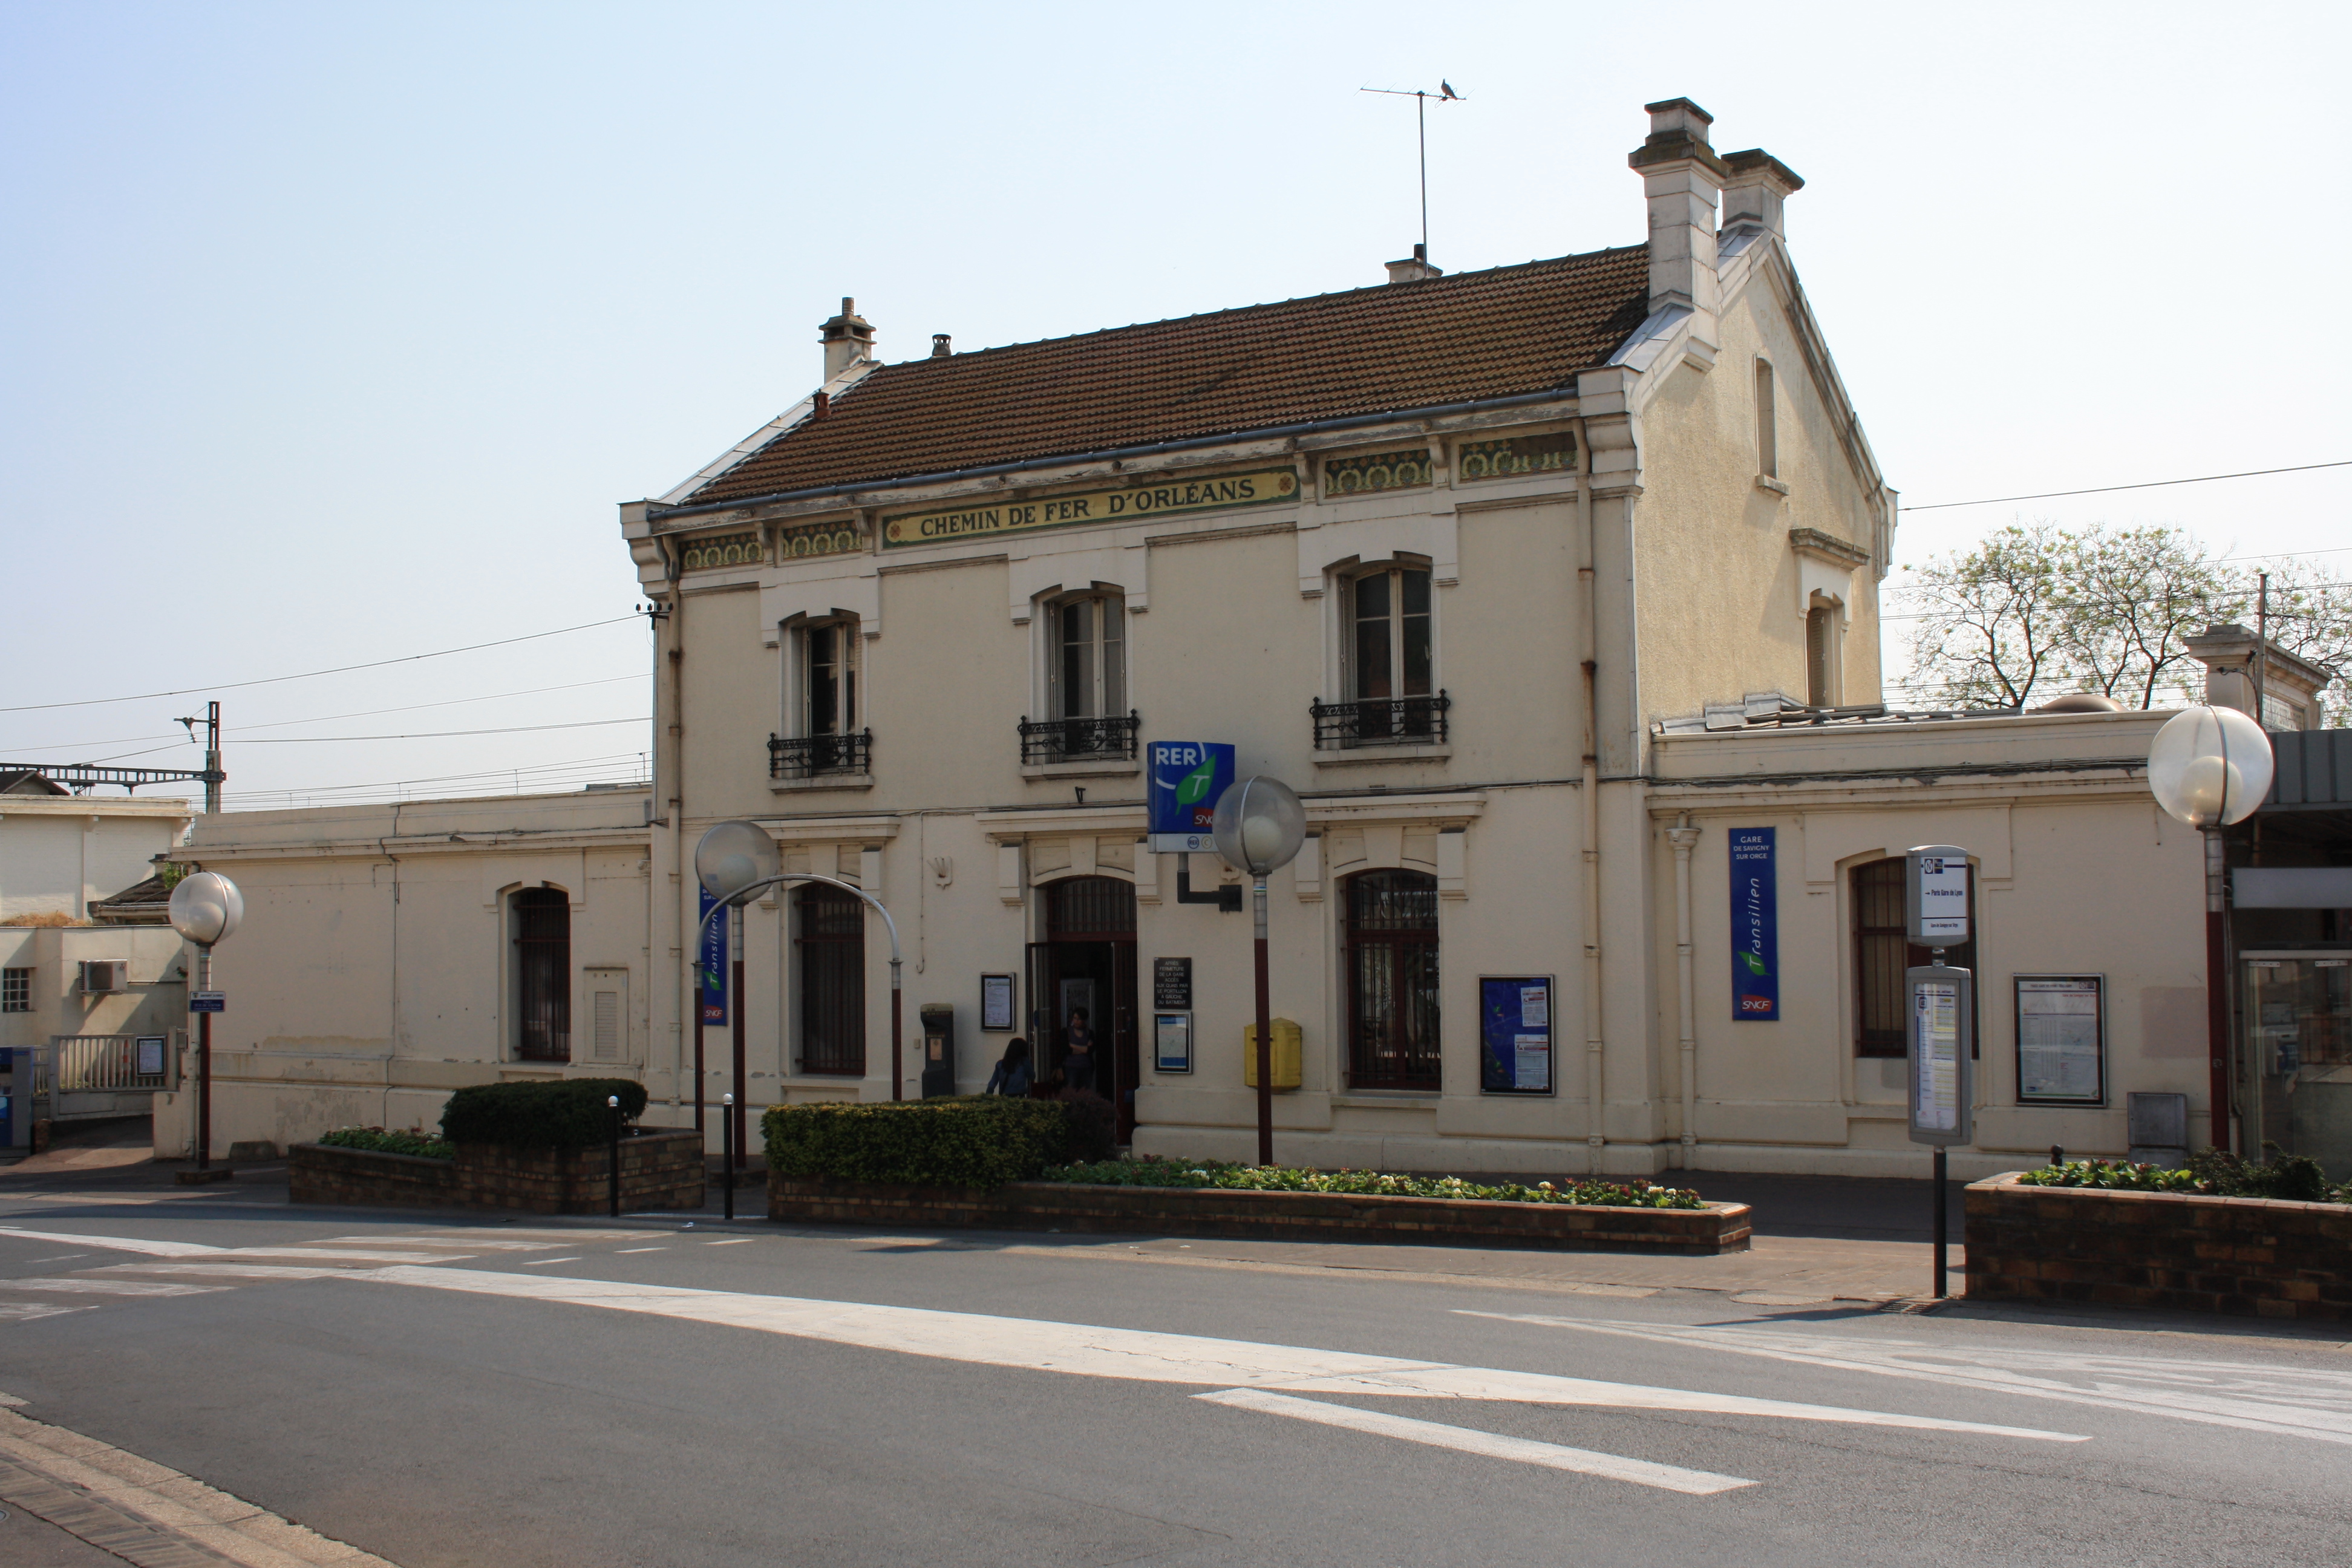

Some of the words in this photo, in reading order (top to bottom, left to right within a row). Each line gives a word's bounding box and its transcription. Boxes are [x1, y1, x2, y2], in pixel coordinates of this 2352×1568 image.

[920, 509, 1000, 537] CHEMIN
[1008, 506, 1036, 526] DE
[1044, 498, 1090, 522] FER
[1108, 479, 1256, 515] D'ORLÉANS
[1156, 747, 1197, 765] RER
[1192, 775, 1210, 797] T
[1194, 815, 1213, 825] SNC
[1748, 878, 1762, 967] Transilien
[710, 914, 718, 984] Transilien
[1742, 1000, 1770, 1010] SNCF
